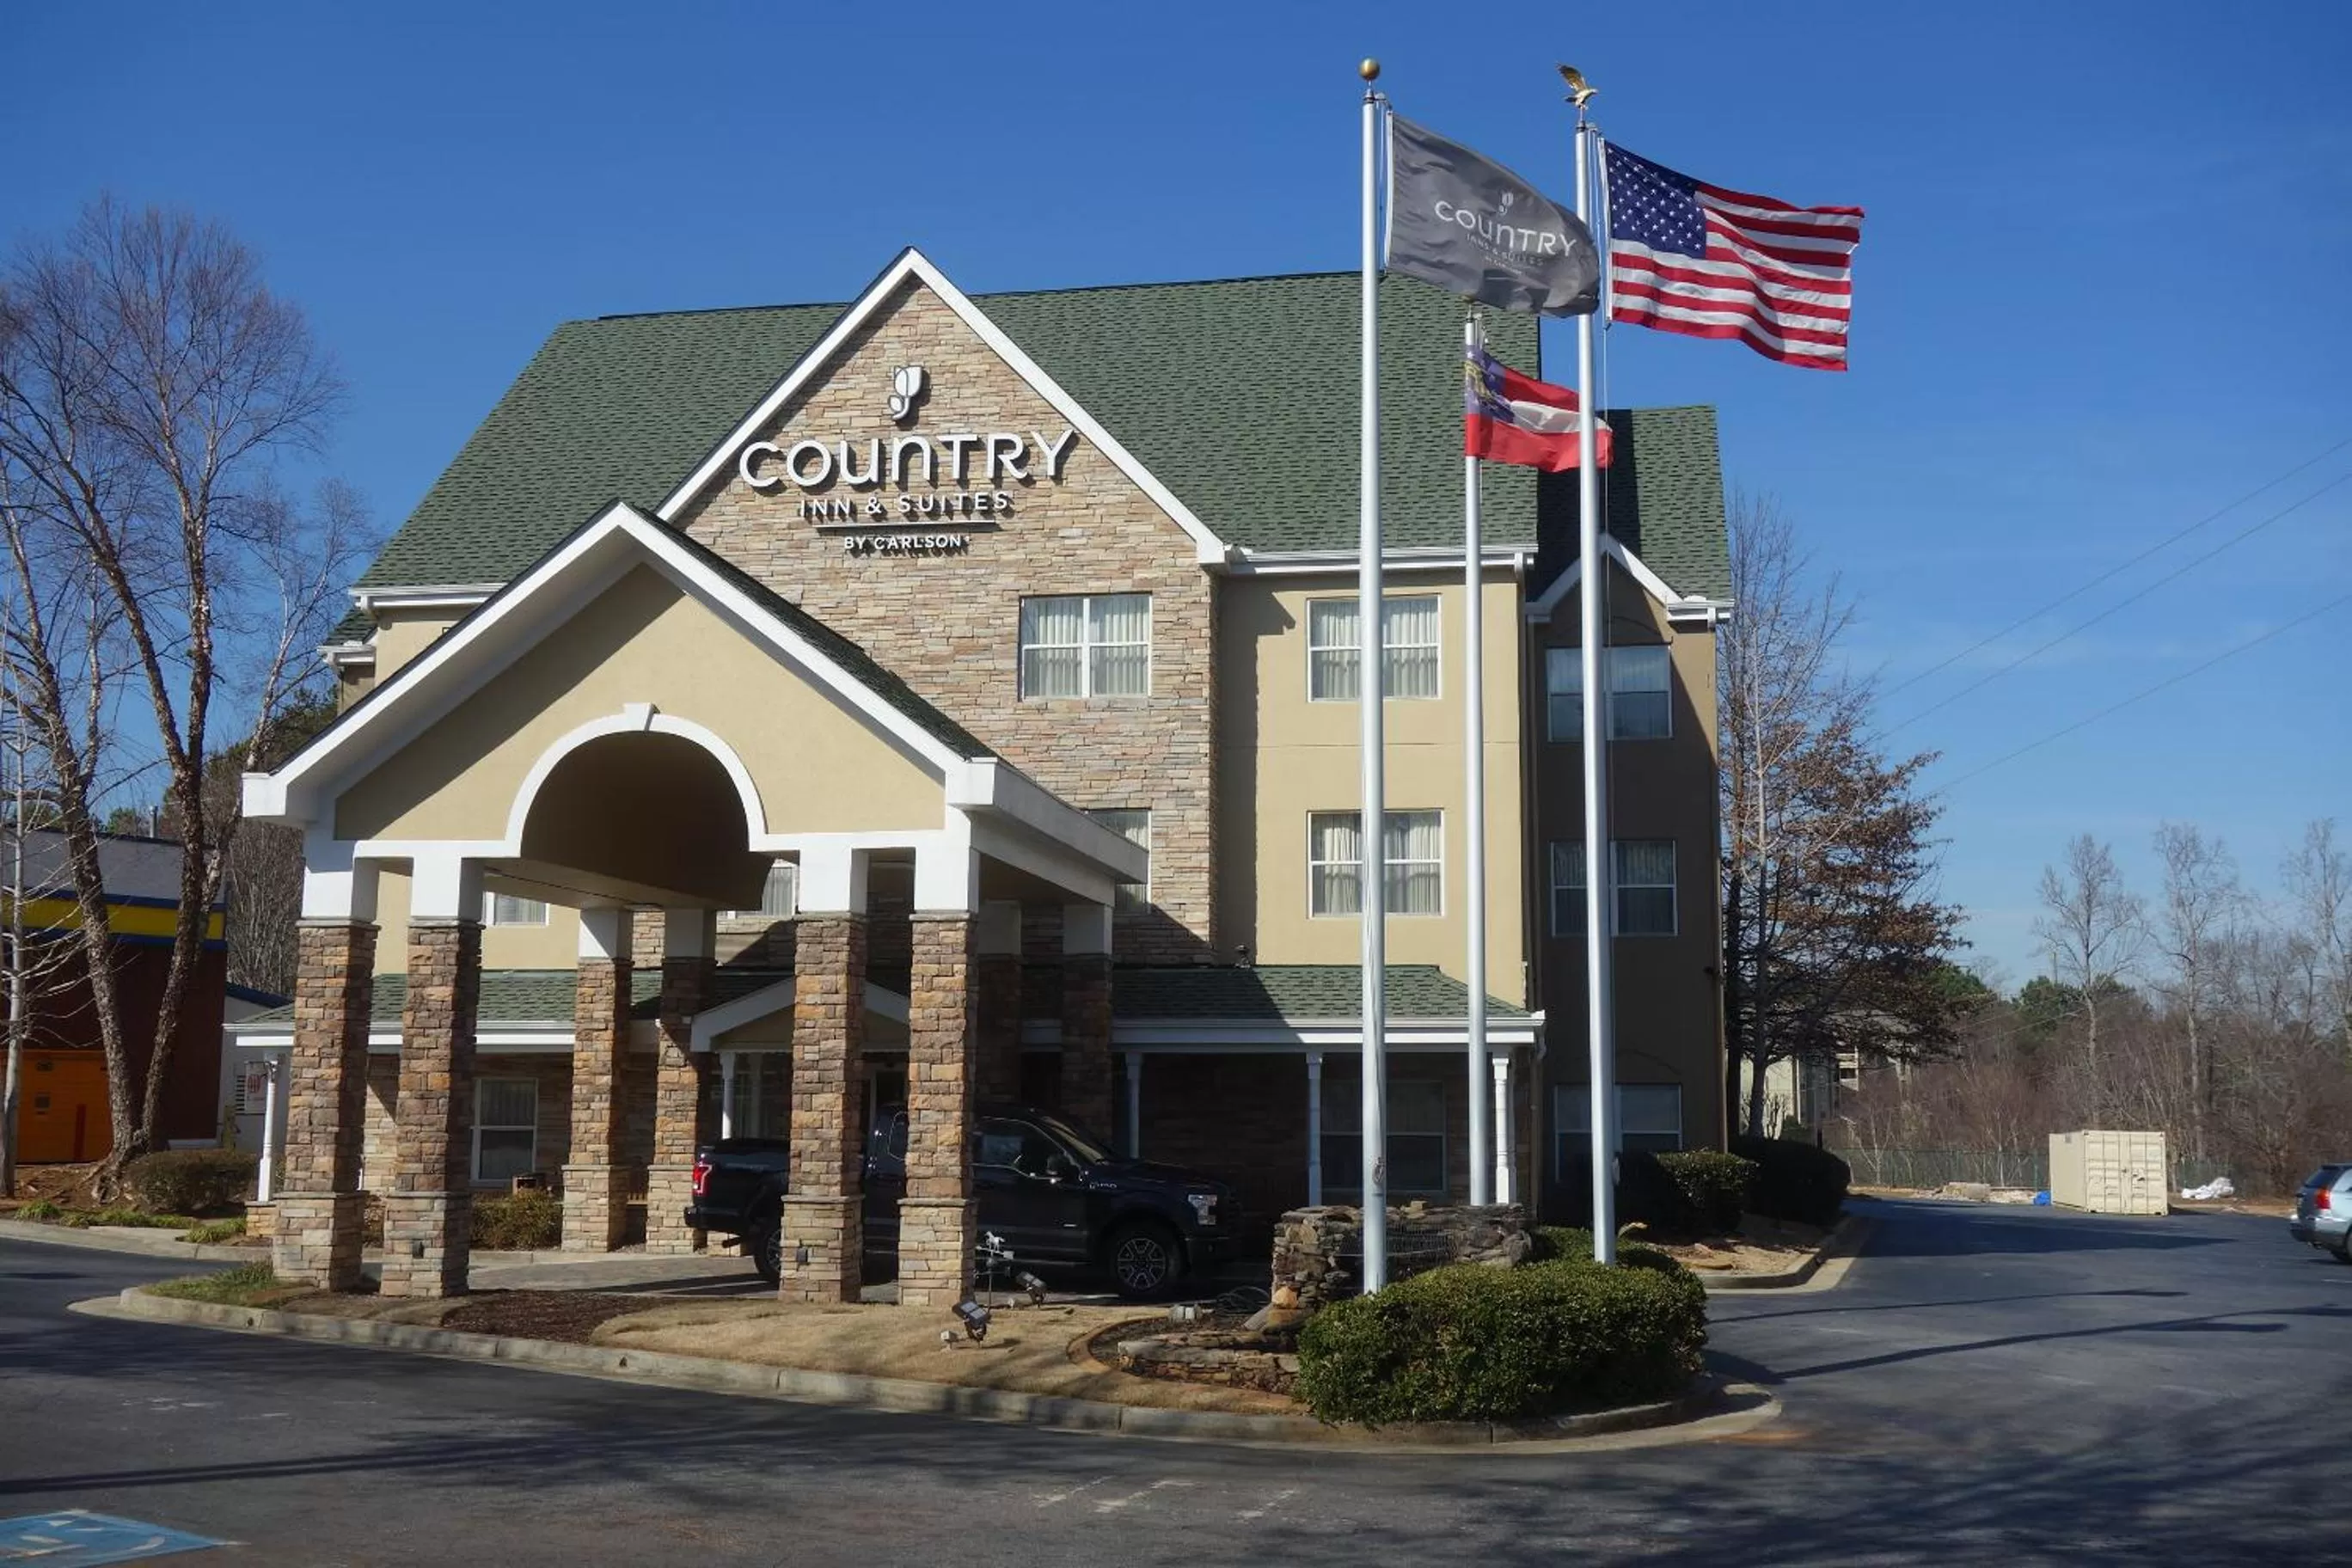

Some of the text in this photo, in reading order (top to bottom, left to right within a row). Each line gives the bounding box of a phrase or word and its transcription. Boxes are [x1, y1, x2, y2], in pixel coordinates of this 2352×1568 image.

[800, 491, 1008, 516] INN & SUITES
[844, 534, 962, 549] BY CARLSON
